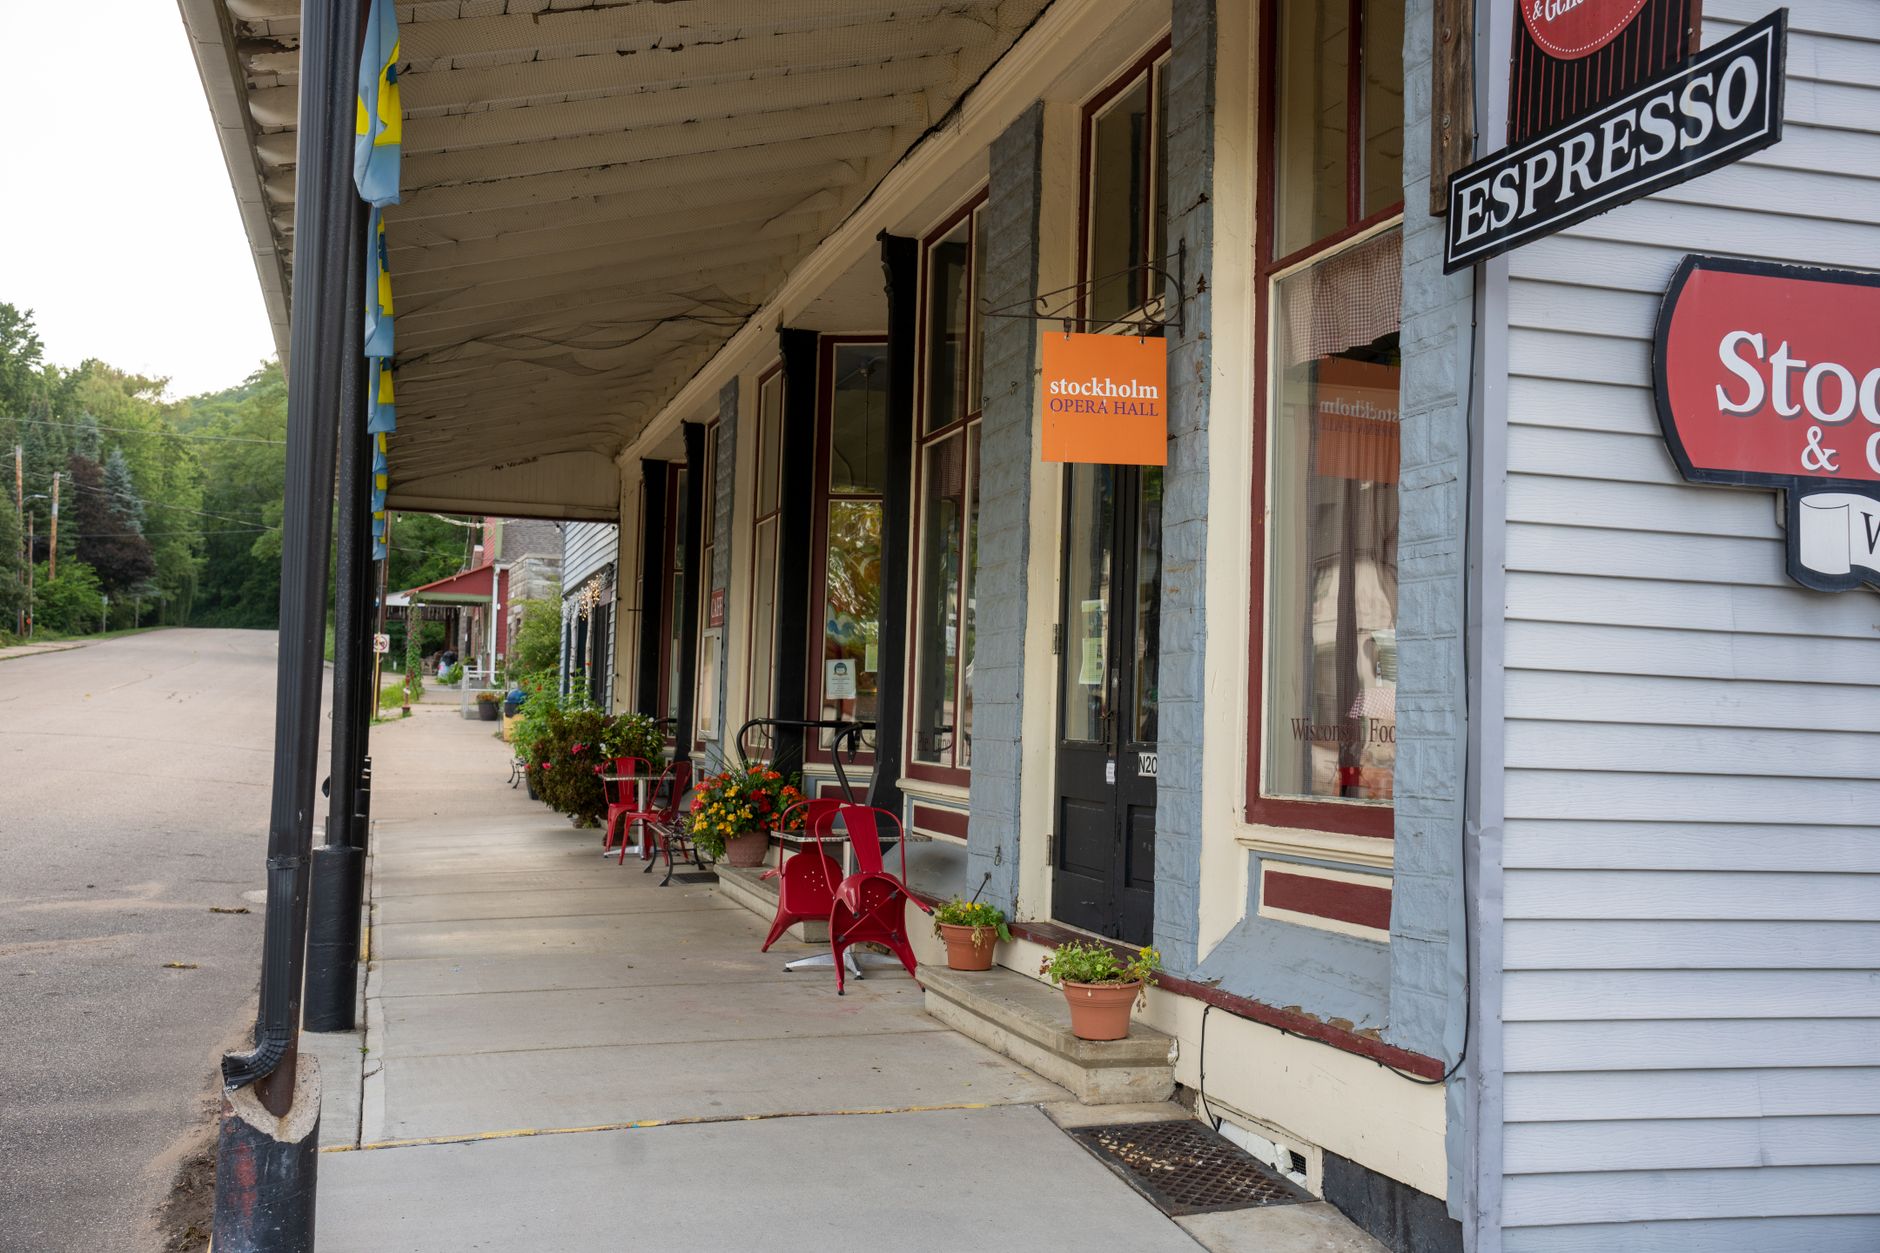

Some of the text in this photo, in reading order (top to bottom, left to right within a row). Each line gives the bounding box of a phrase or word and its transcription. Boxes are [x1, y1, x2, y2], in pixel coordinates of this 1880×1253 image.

[1455, 55, 1760, 247] ESPRESSO
[1049, 377, 1159, 399] stockholm
[1049, 398, 1159, 417] OPERA HALL
[1801, 425, 1839, 472] &
[1291, 718, 1366, 742] Wisconsn
